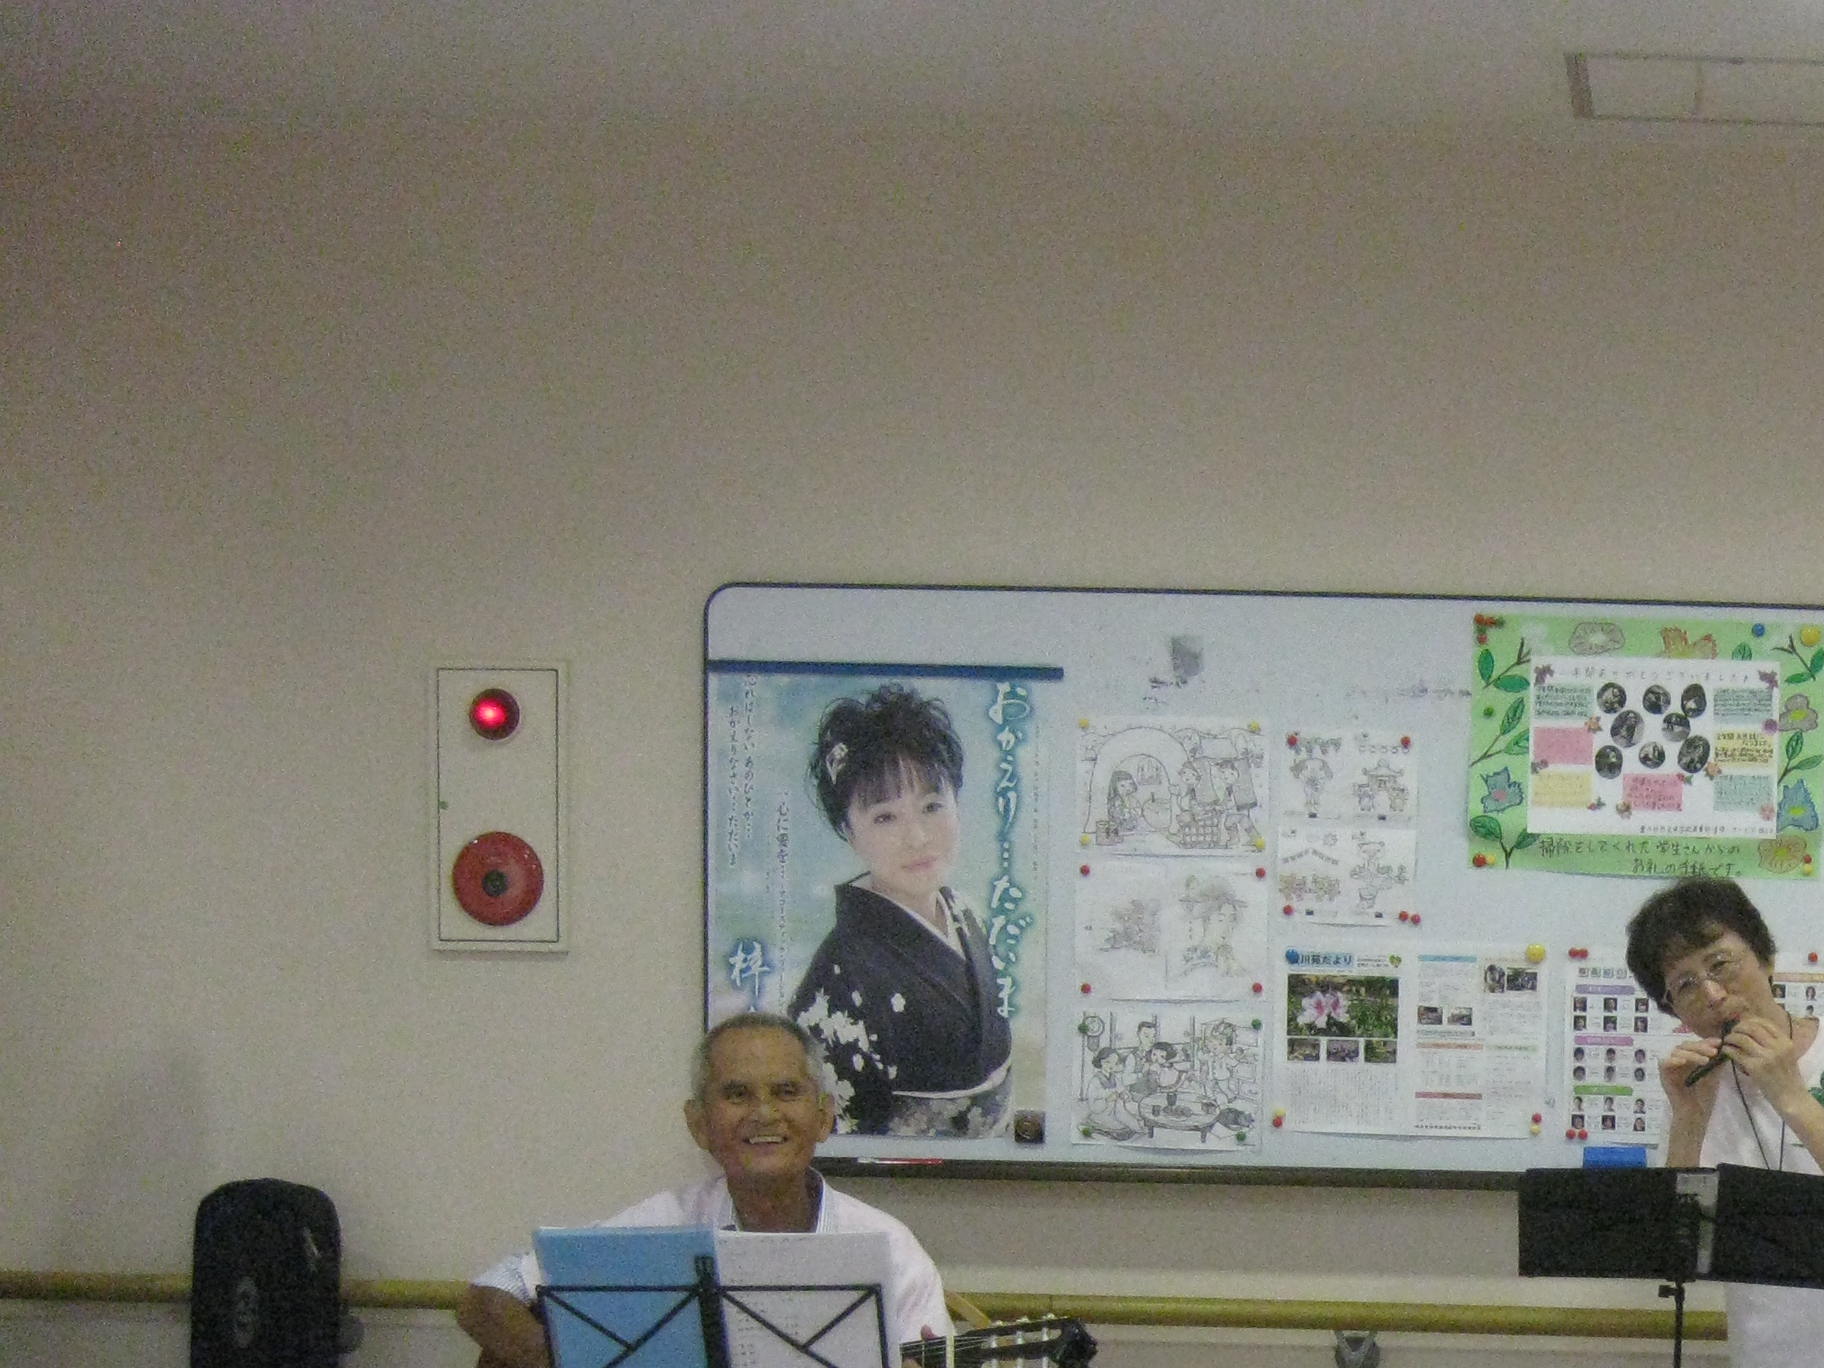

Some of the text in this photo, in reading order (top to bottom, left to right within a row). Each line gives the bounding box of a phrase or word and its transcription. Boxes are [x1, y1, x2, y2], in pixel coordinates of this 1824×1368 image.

[1291, 953, 1352, 966] 川苑だより
